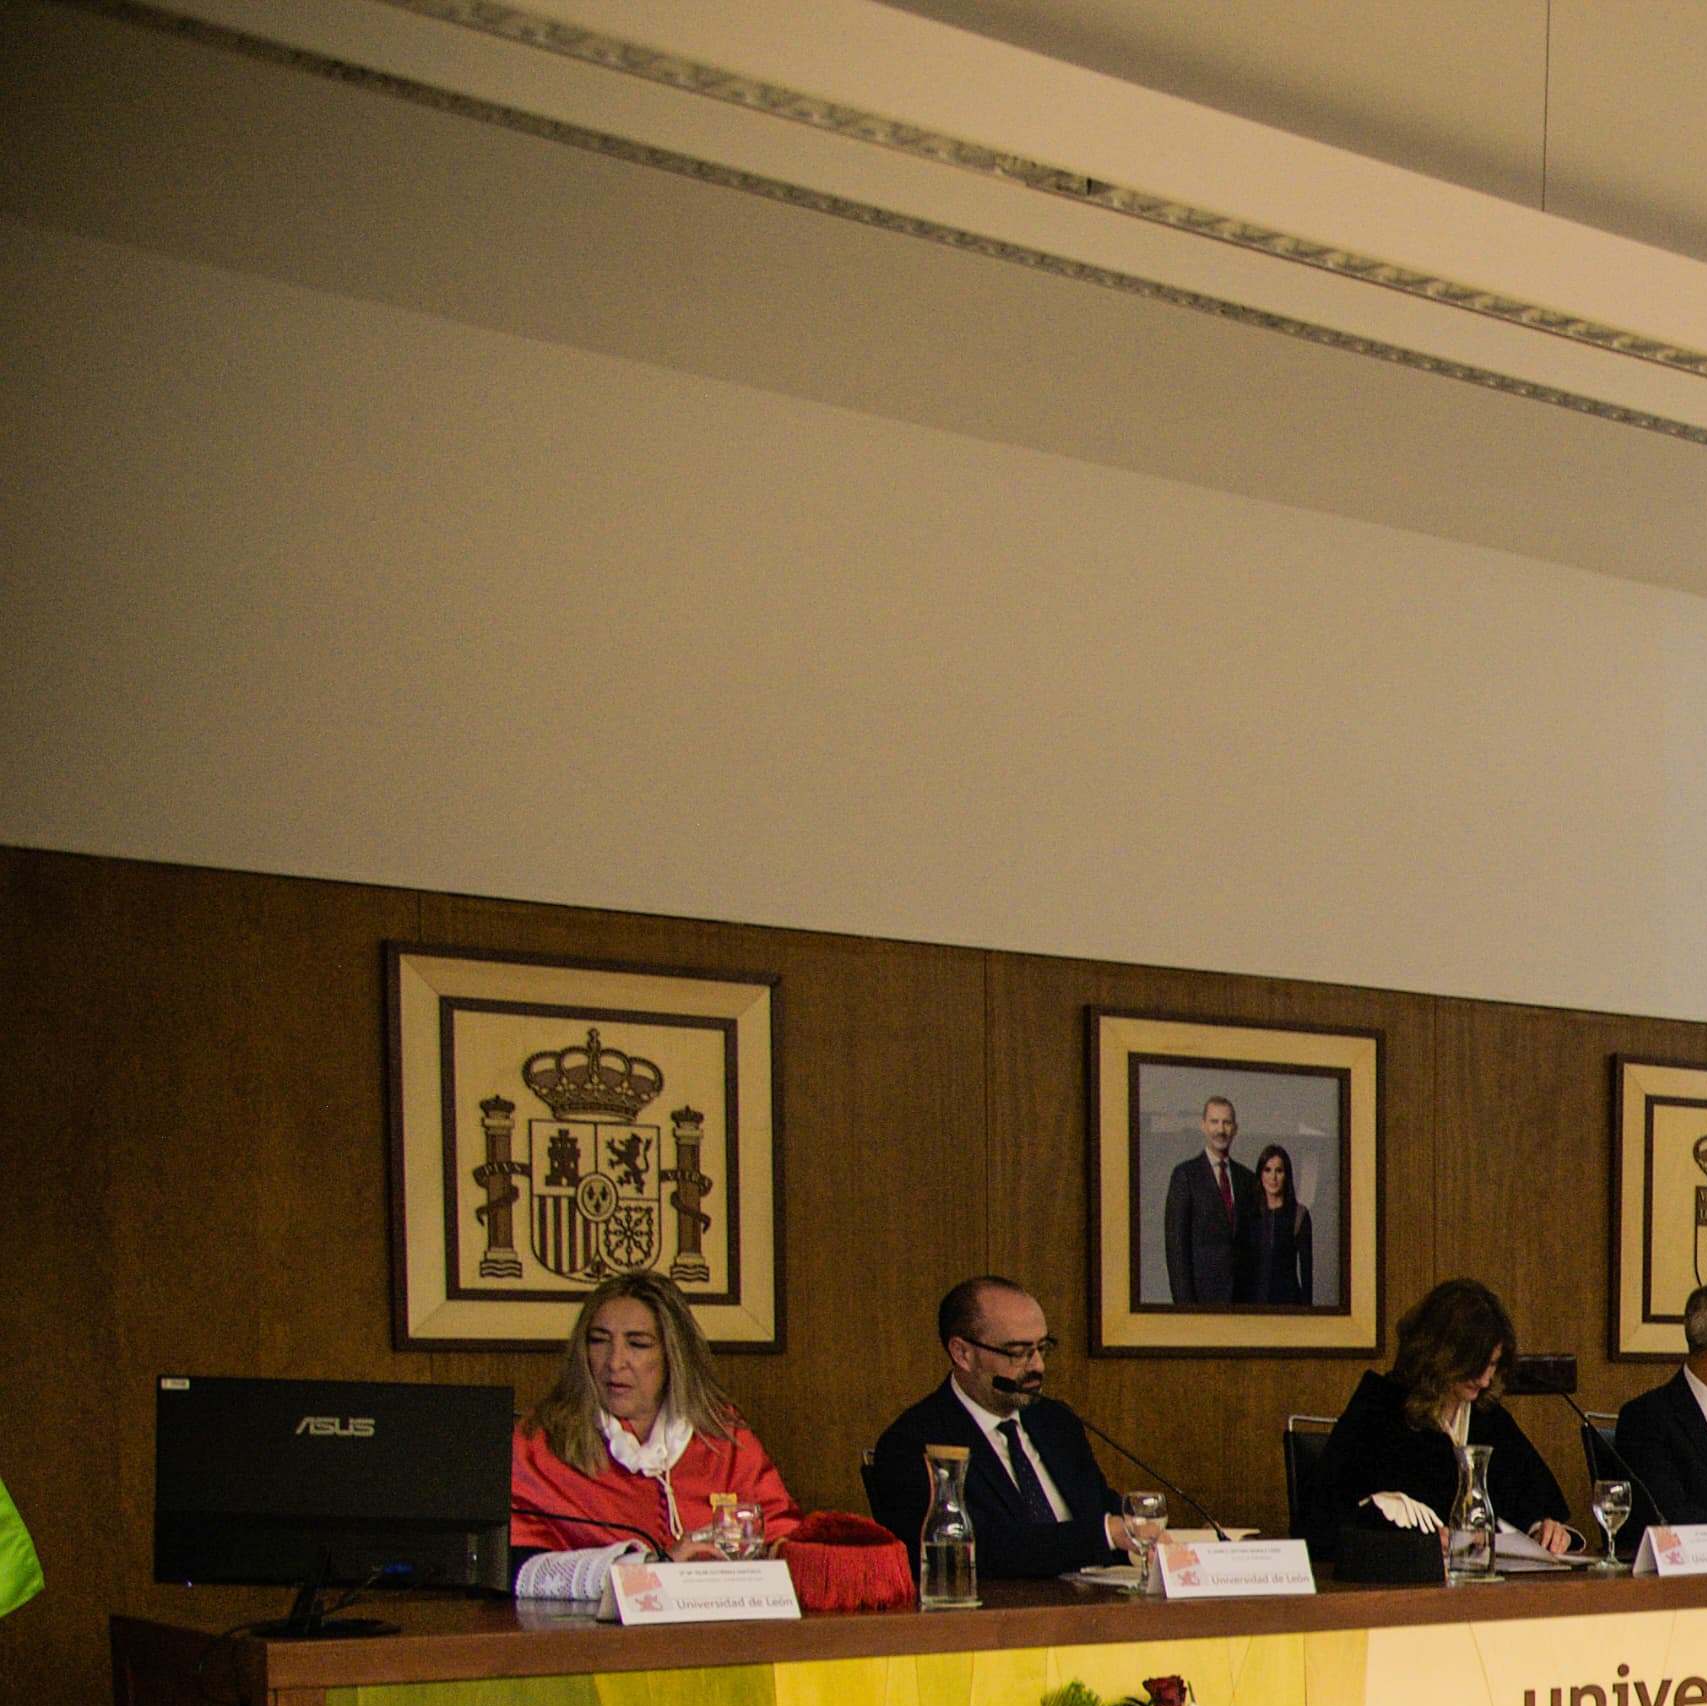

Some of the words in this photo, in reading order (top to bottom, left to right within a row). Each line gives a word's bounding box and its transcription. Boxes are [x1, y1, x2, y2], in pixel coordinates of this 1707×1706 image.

[295, 1416, 376, 1437] ASUS
[1211, 1572, 1268, 1586] Universidad
[676, 1597, 745, 1611] Universidad
[748, 1597, 762, 1608] de
[766, 1596, 793, 1608] León
